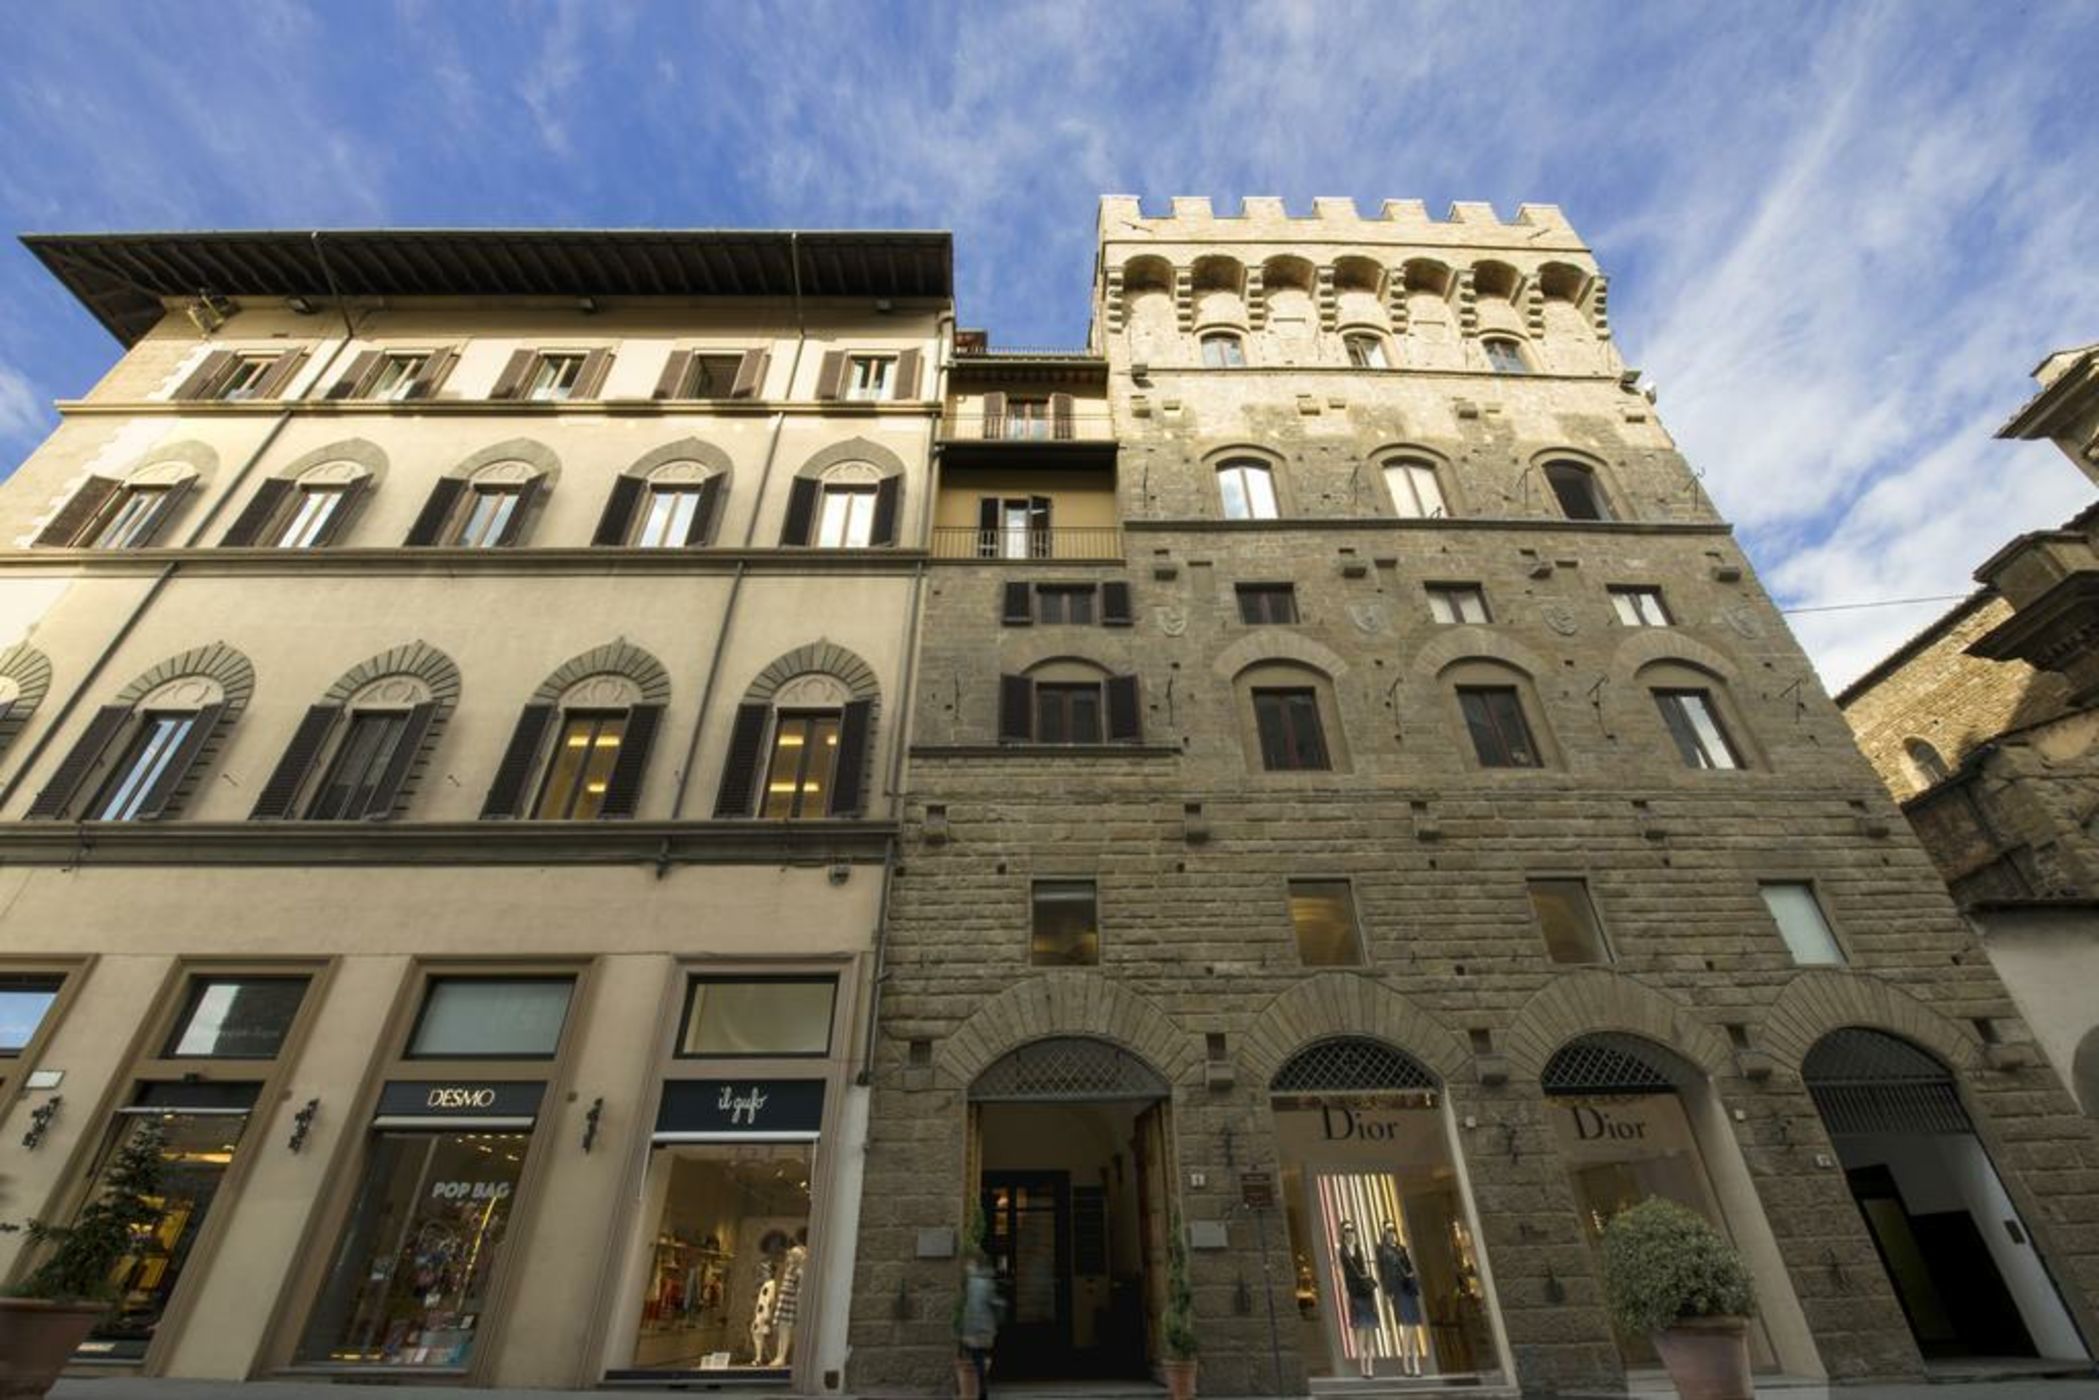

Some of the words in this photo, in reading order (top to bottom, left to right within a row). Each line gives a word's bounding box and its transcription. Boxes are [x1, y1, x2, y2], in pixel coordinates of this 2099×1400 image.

[427, 1088, 496, 1108] DESMO
[719, 1086, 732, 1110] il
[732, 1086, 768, 1125] gufo
[1321, 1103, 1398, 1140] Dior
[1570, 1104, 1646, 1140] Dior
[431, 1181, 471, 1199] POP
[471, 1181, 511, 1199] BAG
